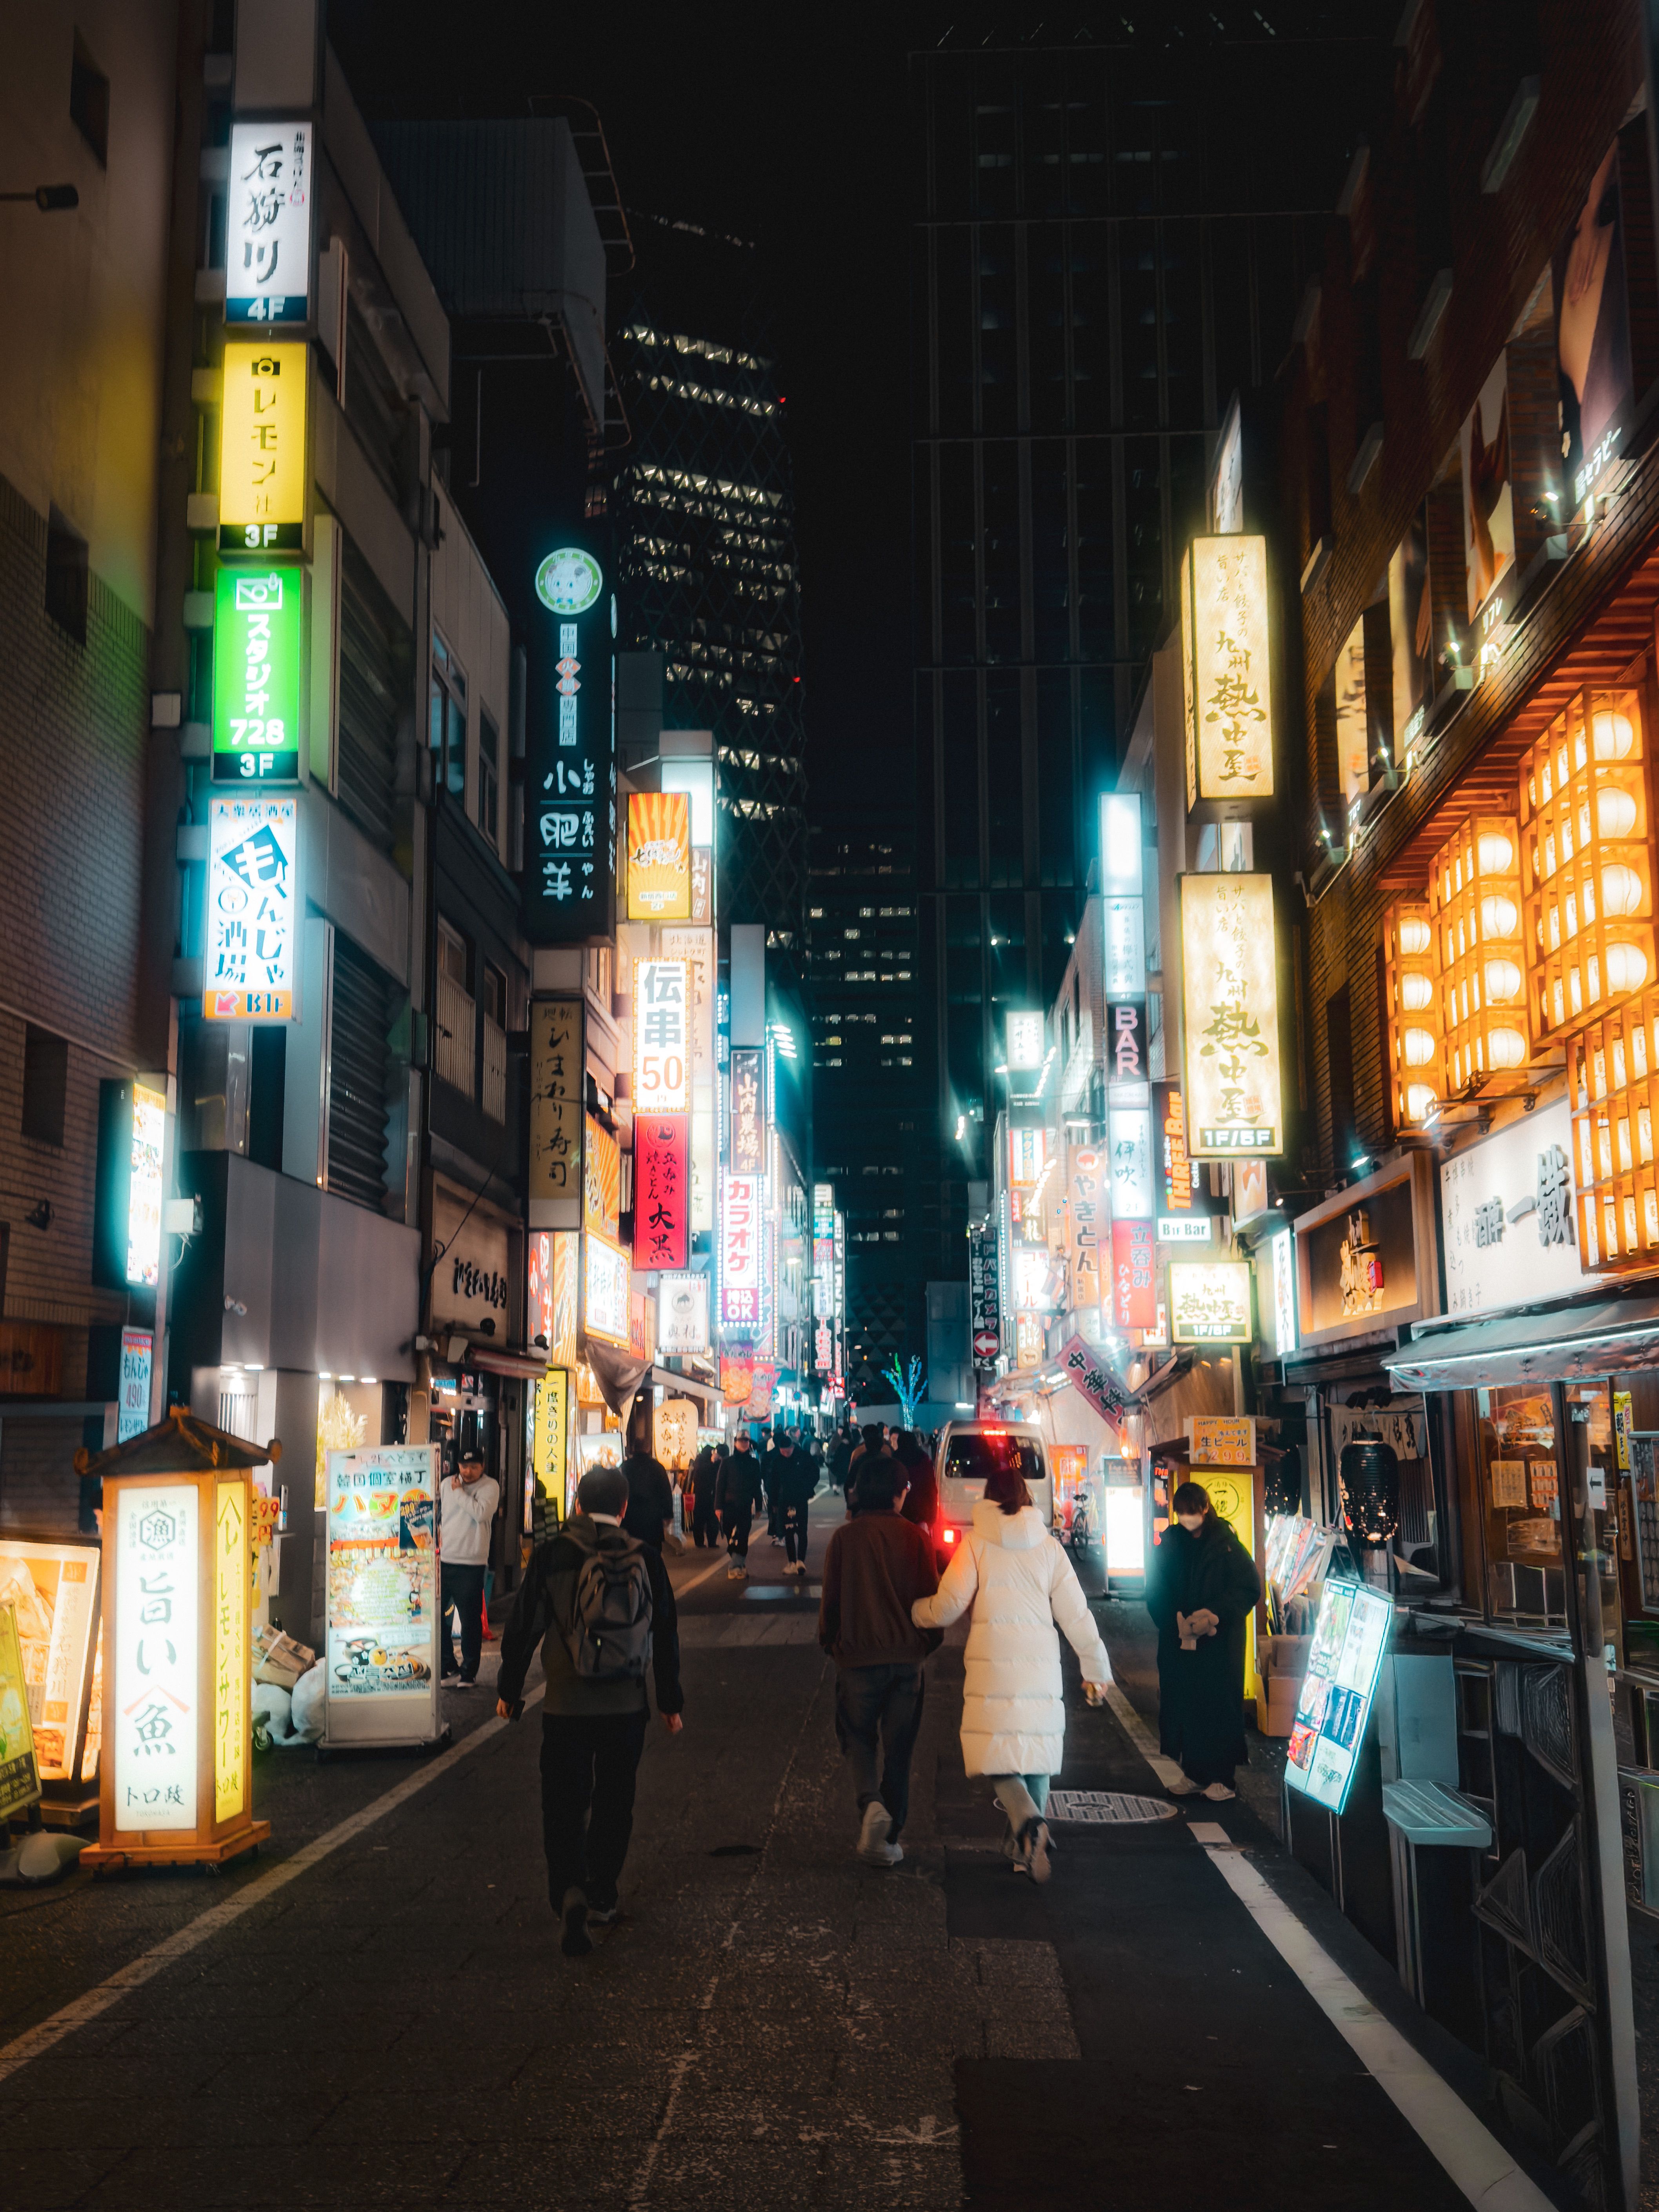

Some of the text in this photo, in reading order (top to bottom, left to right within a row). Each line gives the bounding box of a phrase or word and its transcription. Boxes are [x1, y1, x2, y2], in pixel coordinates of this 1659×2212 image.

[242, 144, 286, 284] 石狩川
[247, 297, 286, 320] 4F
[245, 524, 277, 548] 3F
[1217, 555, 1229, 602] 旨い店
[245, 613, 271, 717] スタジオ
[1216, 631, 1251, 671] 九州
[229, 718, 285, 746] 728
[1206, 673, 1266, 782] 熱中屋
[240, 752, 274, 778] 3F
[540, 760, 581, 901] 小肥羊
[235, 840, 288, 984] もんじゃ
[1216, 885, 1228, 933] 旨い店
[1232, 885, 1247, 970] サバと餃子の
[1216, 962, 1247, 1001] 九州
[644, 965, 682, 1048] 伝串
[1115, 1006, 1141, 1076] BAR
[1200, 1001, 1270, 1126] 熱中屋
[642, 1055, 683, 1091] 50
[543, 1027, 571, 1187] ひまわり寿司
[1204, 1130, 1271, 1147] 1F/6F
[1115, 1140, 1137, 1186] 伊吹
[648, 1202, 675, 1264] 大黒
[728, 1180, 750, 1272] カラオケ
[1074, 1175, 1097, 1273] やきとん
[1184, 1223, 1206, 1235] Bar
[530, 1260, 538, 1295] 小
[1131, 1225, 1151, 1288] 立呑み
[727, 1304, 753, 1319] OK
[1118, 1264, 1131, 1325] ひなどり
[1177, 1292, 1243, 1321] 熱中屋
[1202, 1284, 1226, 1296] 九州
[1201, 1436, 1248, 1448] 生ビール
[220, 1572, 230, 1768] レモンサワー
[127, 1784, 184, 1806] トロ政
